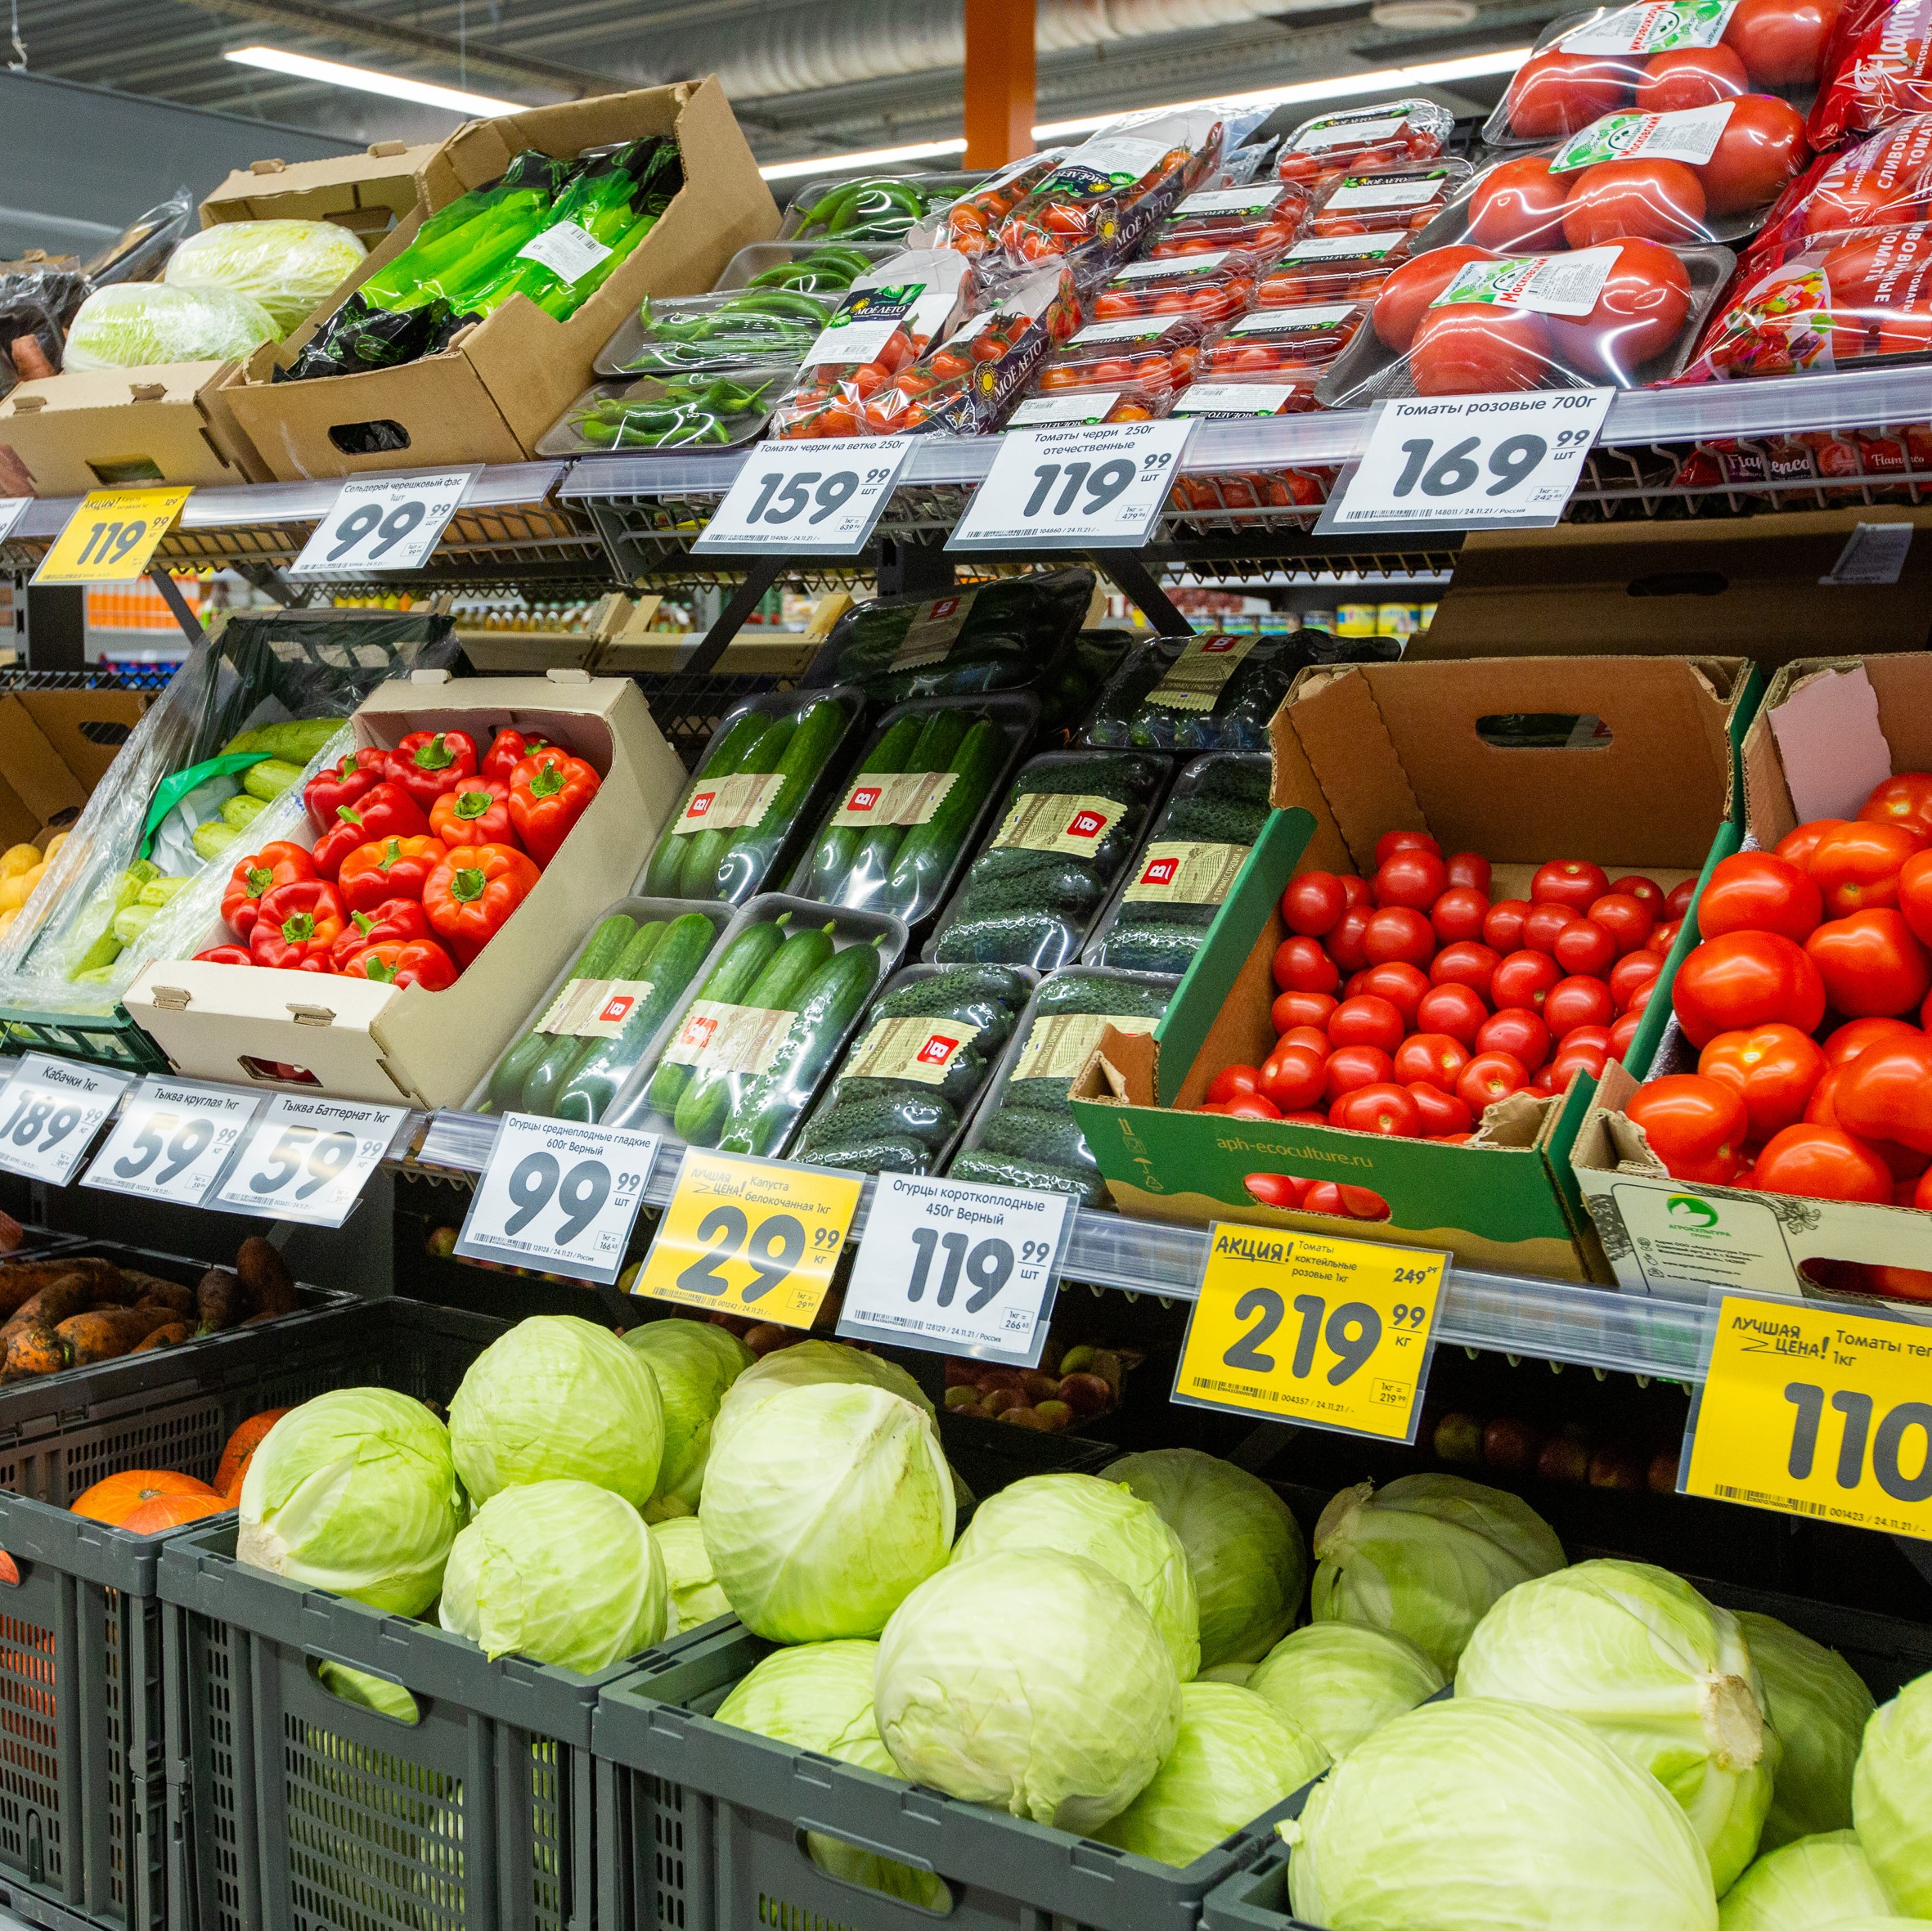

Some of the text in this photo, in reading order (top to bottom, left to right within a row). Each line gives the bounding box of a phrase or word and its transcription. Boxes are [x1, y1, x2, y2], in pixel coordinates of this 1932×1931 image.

[1628, 4, 1668, 51] Московский
[1619, 116, 1662, 156] Московский
[1116, 215, 1142, 249] МОЁ
[1499, 258, 1550, 303] Московский
[878, 305, 905, 313] ЛЕТО
[995, 365, 1018, 402] МОЁ
[1018, 339, 1041, 377] ЛЕТО
[1396, 395, 1597, 416] Томаты розовые 700г
[1035, 424, 1155, 443] Томаты черри 250г
[761, 443, 800, 453] Томаты
[801, 443, 830, 453] черри
[847, 442, 877, 450] ветке
[878, 440, 905, 449] 250г
[1043, 440, 1135, 456] отечественные
[1553, 451, 1576, 460] шт
[1392, 429, 1591, 497] 169 99
[344, 478, 462, 493] Сельдерей черешковый фас
[1022, 452, 1172, 517] 119 99
[1140, 473, 1160, 482] шт
[746, 468, 891, 525] 159 99
[860, 487, 878, 496] шт
[83, 497, 122, 510] АКЦИЯ!
[1464, 507, 1494, 515] 24.11.21
[1499, 507, 1525, 515] Россия
[77, 516, 169, 564] 119 99
[326, 501, 451, 562] 99 99
[1214, 878, 1229, 896] ПРЯМО
[1227, 853, 1242, 877] ГРЯДКИ
[882, 1026, 897, 1044] ПРЯМО
[1036, 1023, 1063, 1067] ПРЯМО ГРЯДКИ
[43, 1066, 98, 1091] Кабачки 1кг
[155, 1088, 240, 1111] Тыква круглая 1кг
[0, 1089, 103, 1152] 189 99
[282, 1099, 390, 1124] Тыква Баттернат 1кг
[509, 1117, 651, 1148] Огурцы среднеплодные гладкие
[114, 1112, 238, 1186] 59 99
[546, 1138, 604, 1156] 600г Верный
[1216, 1135, 1374, 1169] aph-ecoculture.ru
[249, 1125, 383, 1201] 59 99
[690, 1168, 731, 1183] ЛУЧШАЯ
[749, 1175, 790, 1192] Капуста
[504, 1152, 640, 1246] 99 99
[713, 1181, 747, 1197] ЦЕНА!
[893, 1179, 1045, 1212] Огурцы короткоплодные
[614, 1197, 630, 1207] шт
[744, 1191, 831, 1215] белокочанная 1кг
[926, 1203, 1004, 1225] 450г Верный
[553, 1248, 573, 1258] 24.11.21
[577, 1252, 595, 1262] Россия
[600, 1242, 611, 1251] 166
[676, 1205, 840, 1304] 29 99
[1215, 1235, 1294, 1263] АКЦИЯ!
[1298, 1240, 1335, 1254] Томаты
[813, 1255, 827, 1264] кг
[1294, 1254, 1358, 1272] коктейльные
[907, 1227, 1050, 1314] 119 99
[1020, 1269, 1040, 1280] шт
[1292, 1268, 1349, 1283] розовые 1кг
[1392, 1267, 1427, 1285] 249
[717, 1300, 764, 1315] 001242 24.11.21
[796, 1300, 807, 1309] 29
[925, 1323, 1002, 1343] 128129 24.11.21 Россия
[1004, 1319, 1021, 1330] 266
[1732, 1316, 1801, 1339] ЛУЧШАЯ
[1222, 1287, 1426, 1386] 219 99
[1395, 1336, 1412, 1348] кг
[1835, 1330, 1901, 1354] Томаты
[1775, 1336, 1830, 1360] ЦЕНА!
[1833, 1351, 1857, 1367] 1кг
[1281, 1394, 1345, 1413] 004357 24.11.21
[1379, 1392, 1396, 1403] 219
[1784, 1381, 1932, 1502] 110
[1829, 1507, 1912, 1532] 001423 24.11.21
